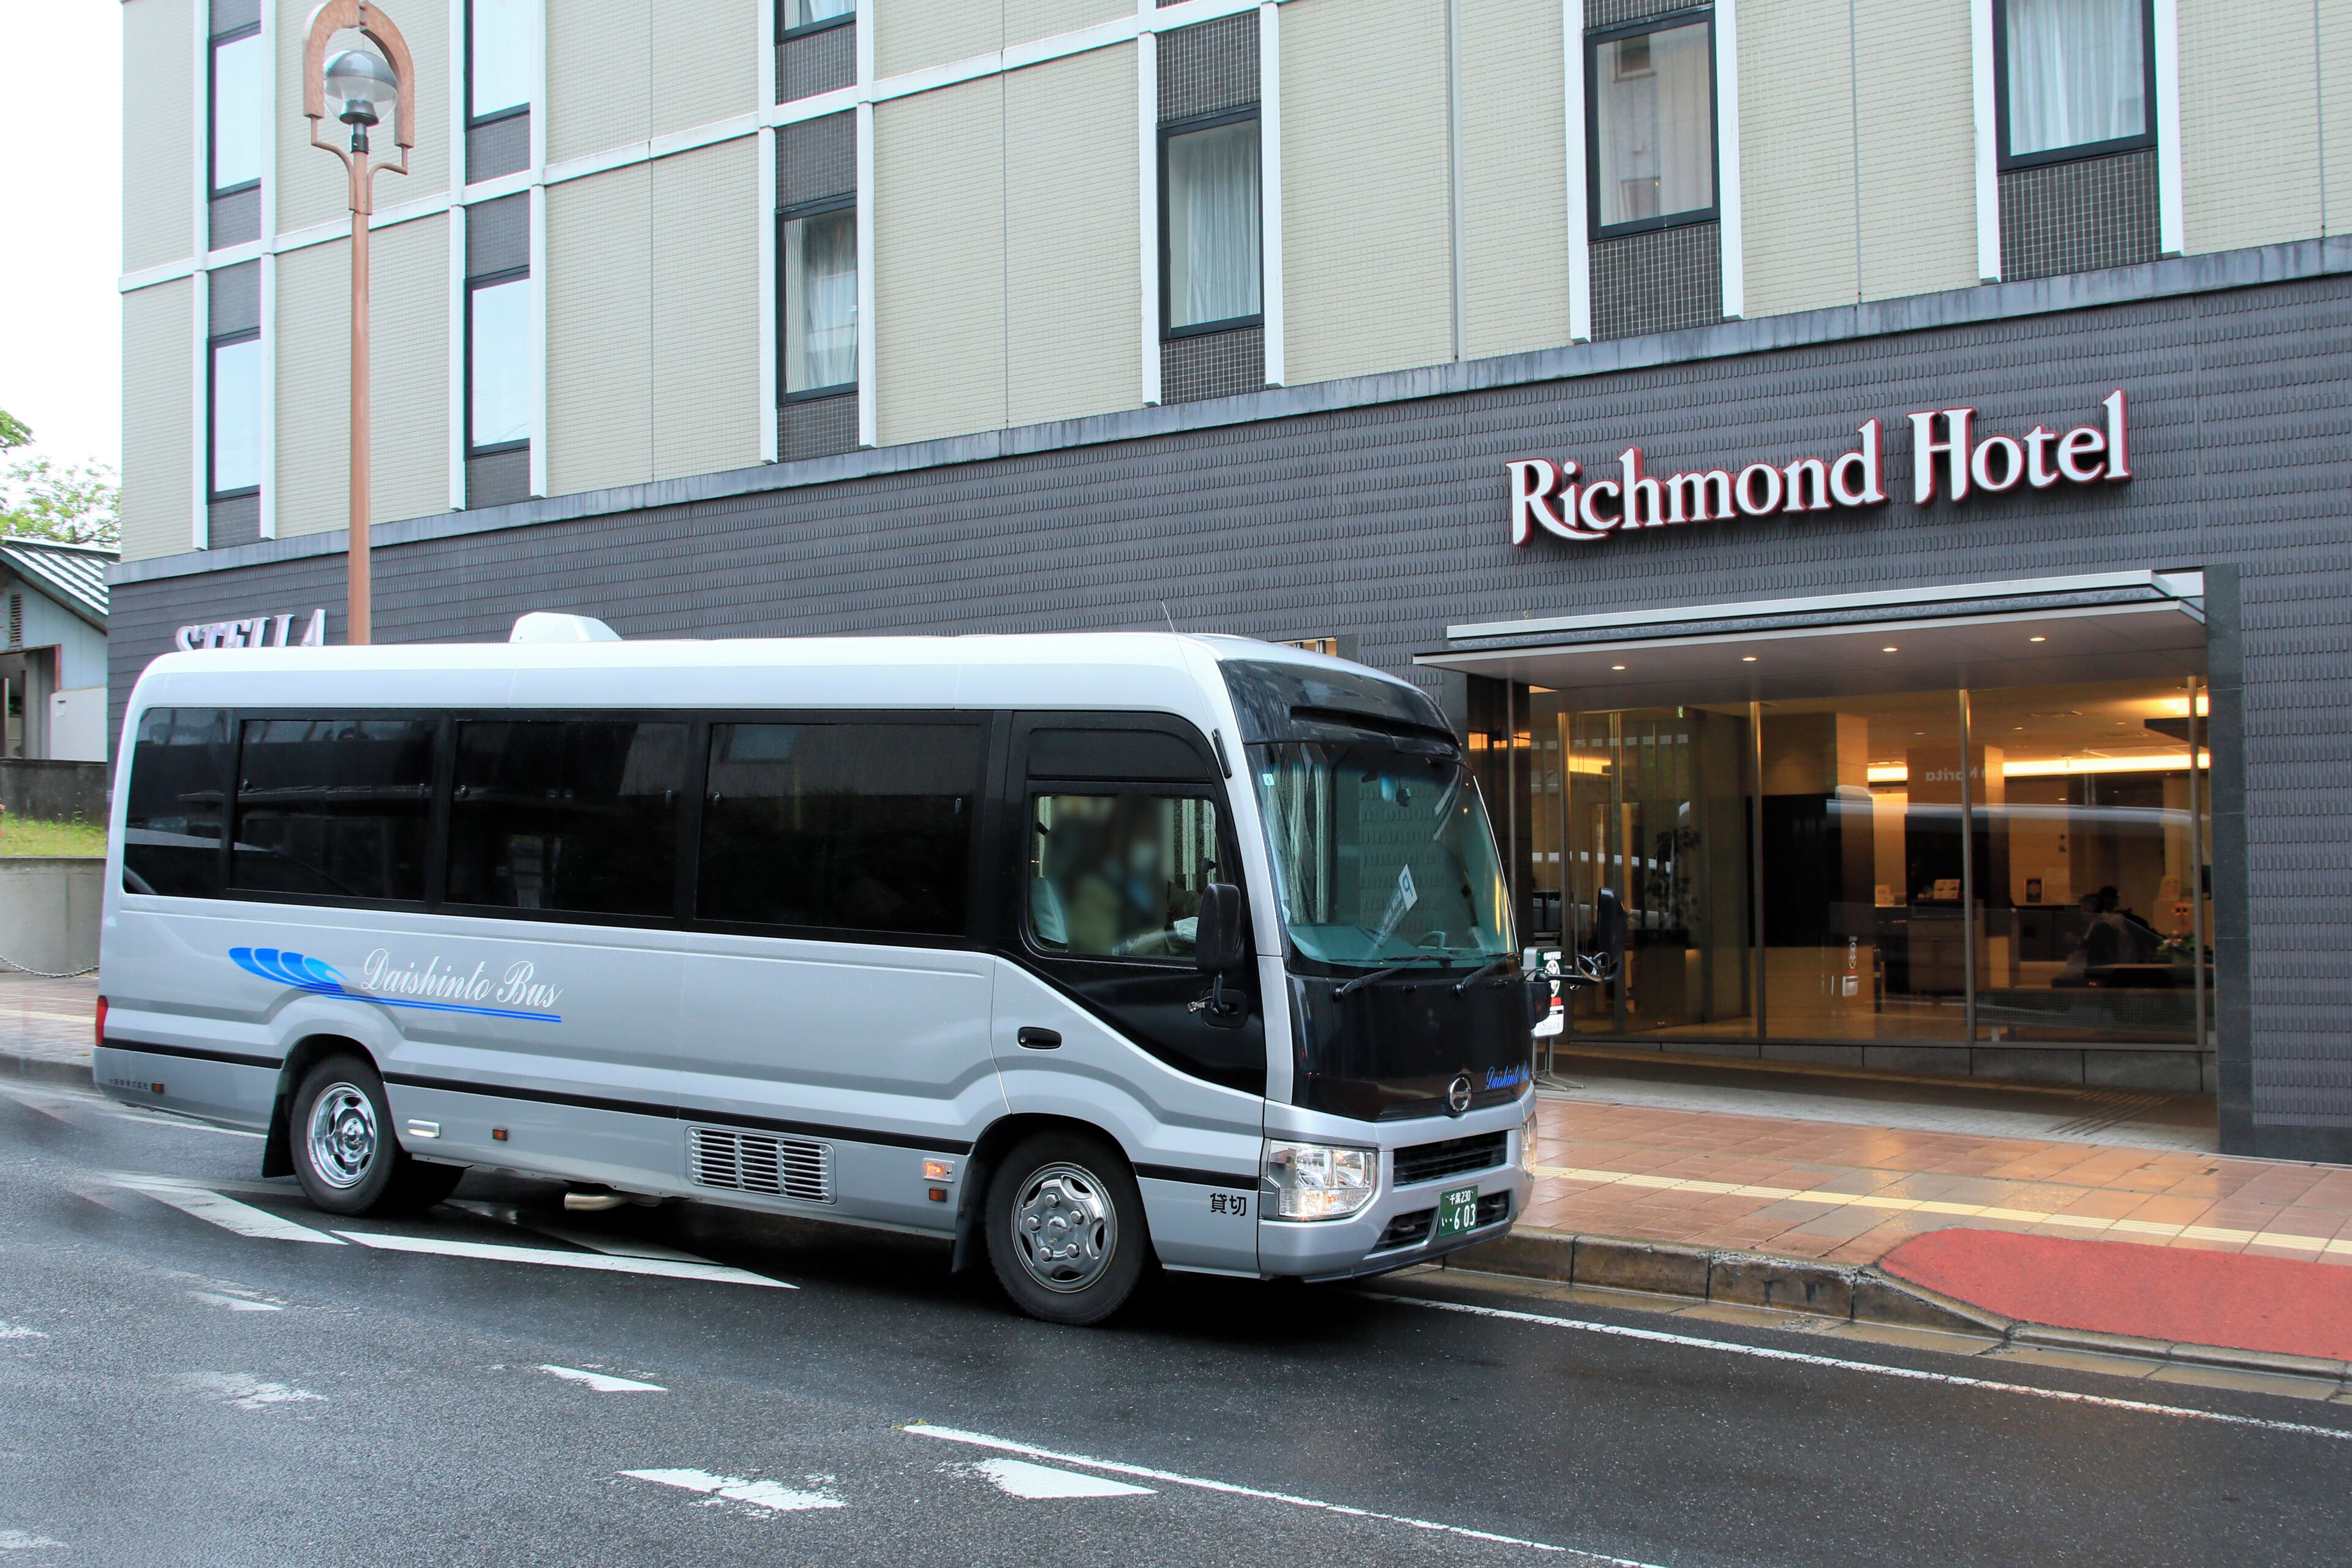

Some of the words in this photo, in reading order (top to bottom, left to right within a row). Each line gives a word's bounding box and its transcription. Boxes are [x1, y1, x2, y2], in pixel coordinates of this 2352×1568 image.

[1506, 417, 1890, 547] Richmond
[1907, 388, 2133, 507] Hotel
[361, 948, 496, 1001] Daishinto
[497, 960, 564, 1008] Bus
[1210, 1193, 1246, 1216] 貸切
